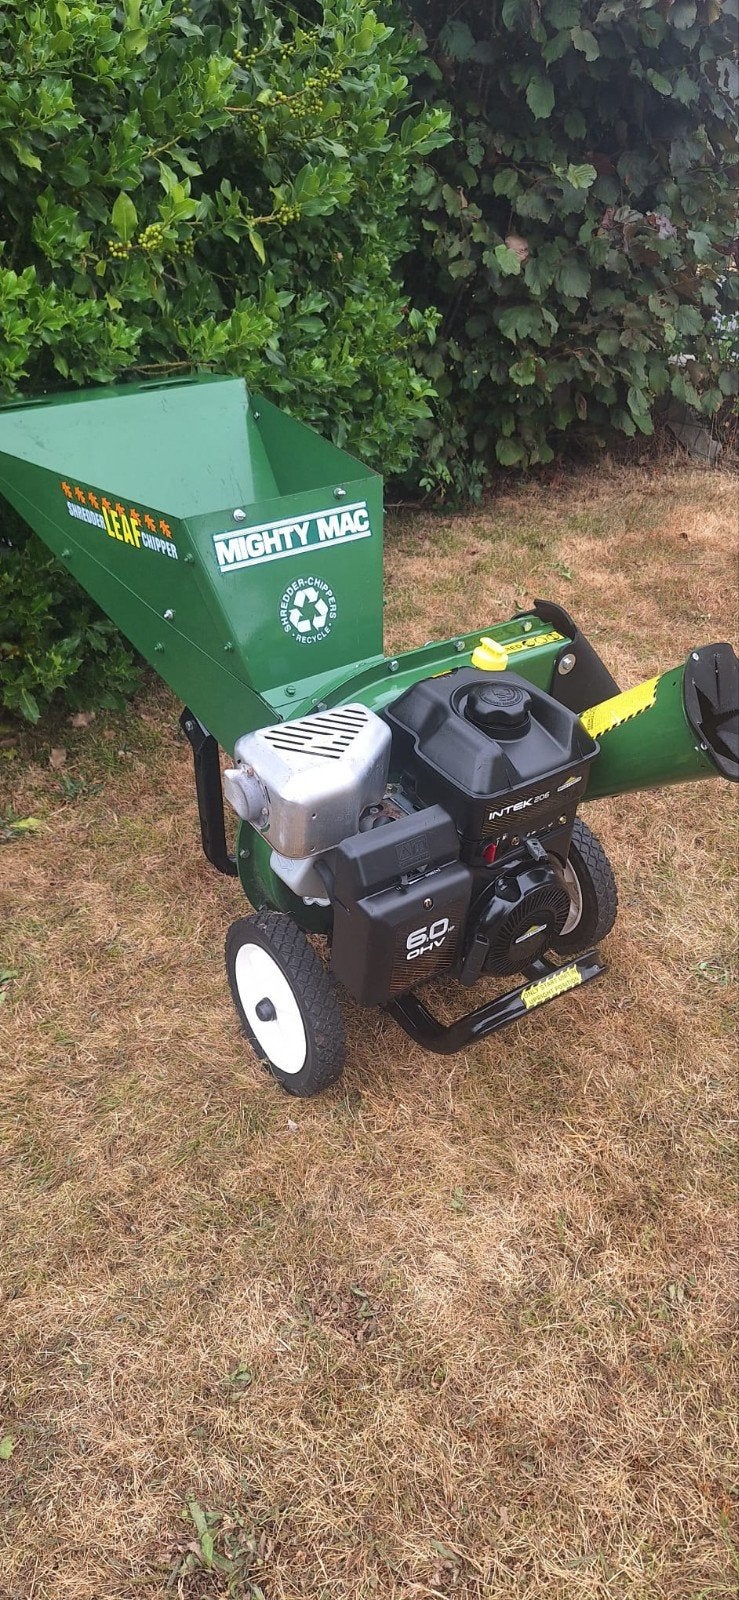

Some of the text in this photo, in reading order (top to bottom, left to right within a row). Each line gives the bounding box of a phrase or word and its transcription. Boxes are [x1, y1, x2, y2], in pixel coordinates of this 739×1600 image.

[67, 501, 106, 530] SHREDDER
[102, 506, 141, 548] LEAF
[141, 532, 178, 560] CHIPPER
[215, 509, 370, 565] MIGHTY MAC
[280, 577, 336, 632] SHREDDER-CHIPPERS
[296, 626, 330, 643] RECYCLE
[489, 792, 550, 820] INTEK 206
[407, 918, 449, 949] 6.0
[407, 937, 446, 960] OHV
